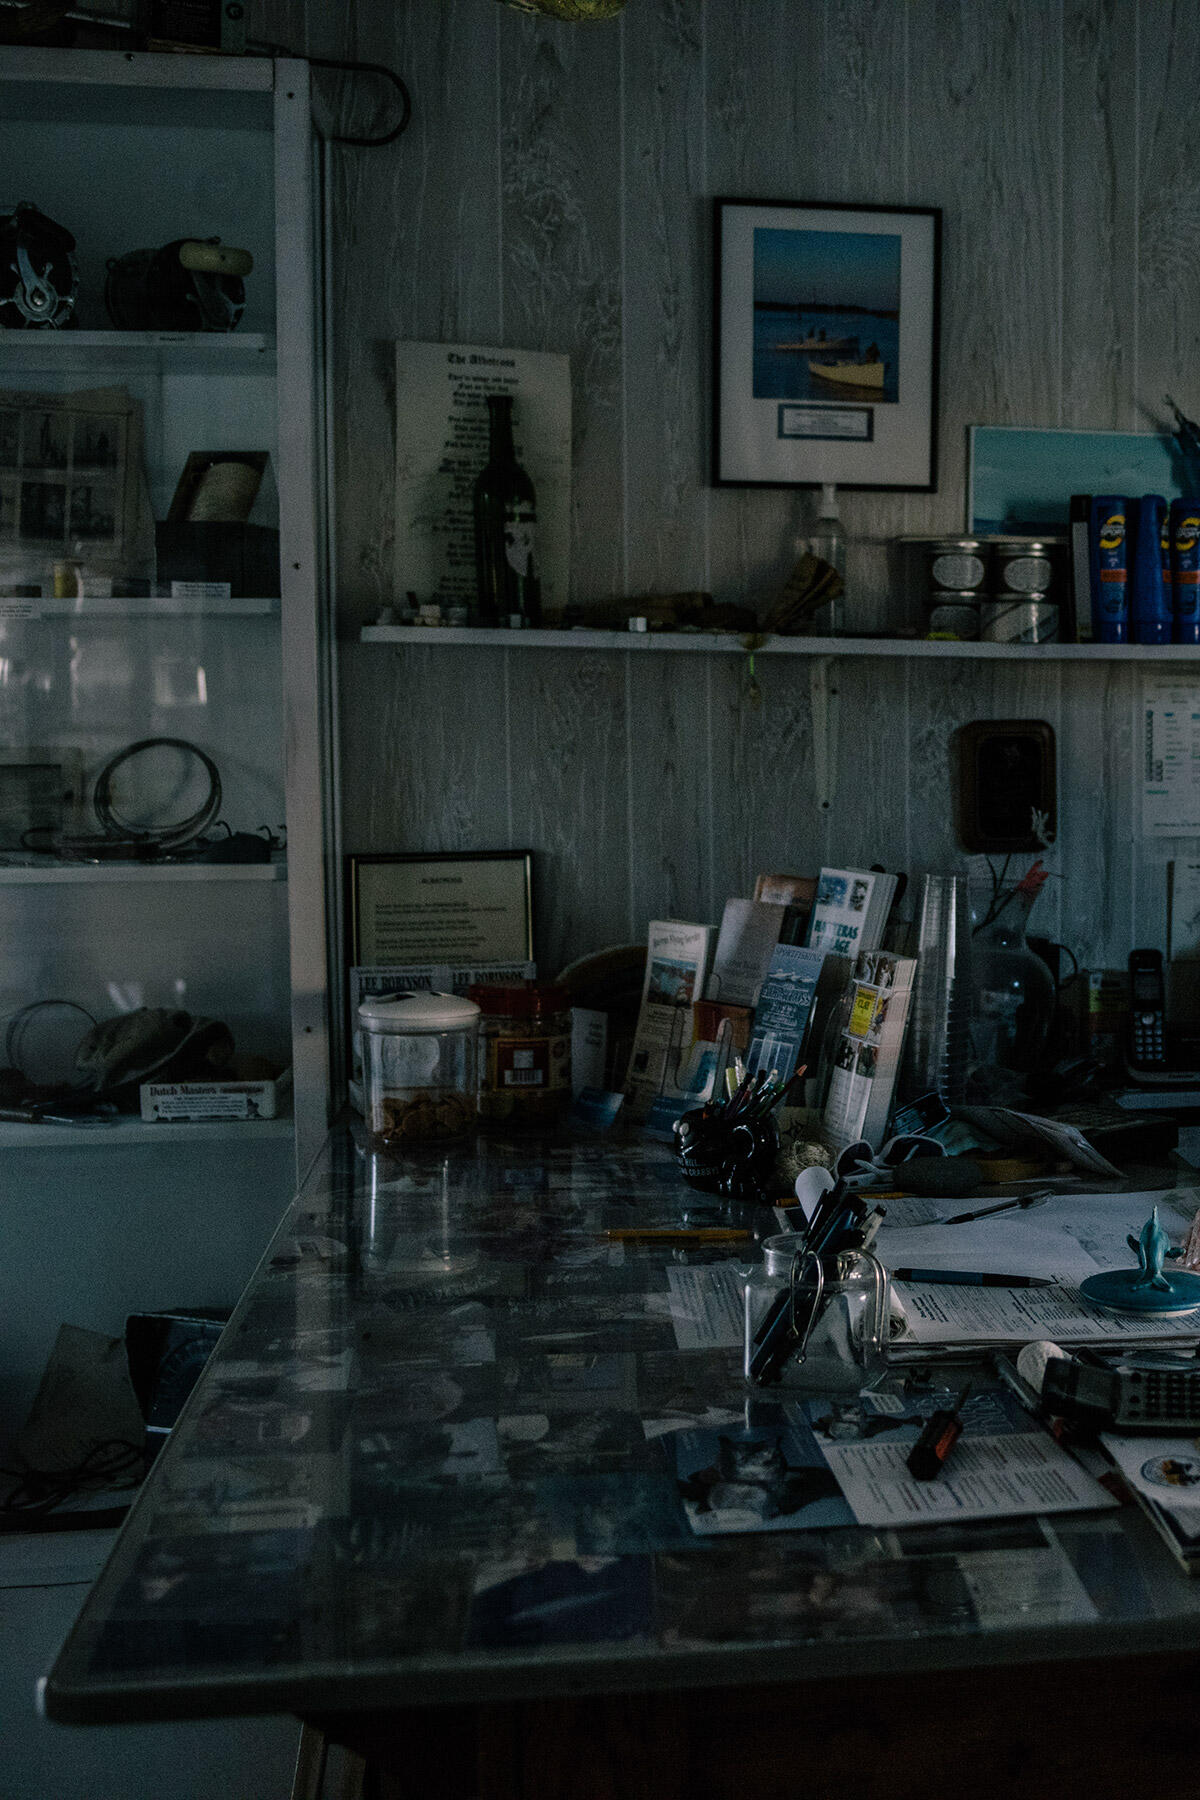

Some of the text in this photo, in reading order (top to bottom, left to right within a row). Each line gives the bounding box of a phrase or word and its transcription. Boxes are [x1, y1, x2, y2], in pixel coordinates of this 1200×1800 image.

[448, 353, 466, 365] The
[359, 975, 432, 991] LEE ROBINSON
[452, 970, 523, 986] LEE ROBINSON
[150, 1086, 178, 1097] Dutch
[180, 1085, 217, 1095] Masters
